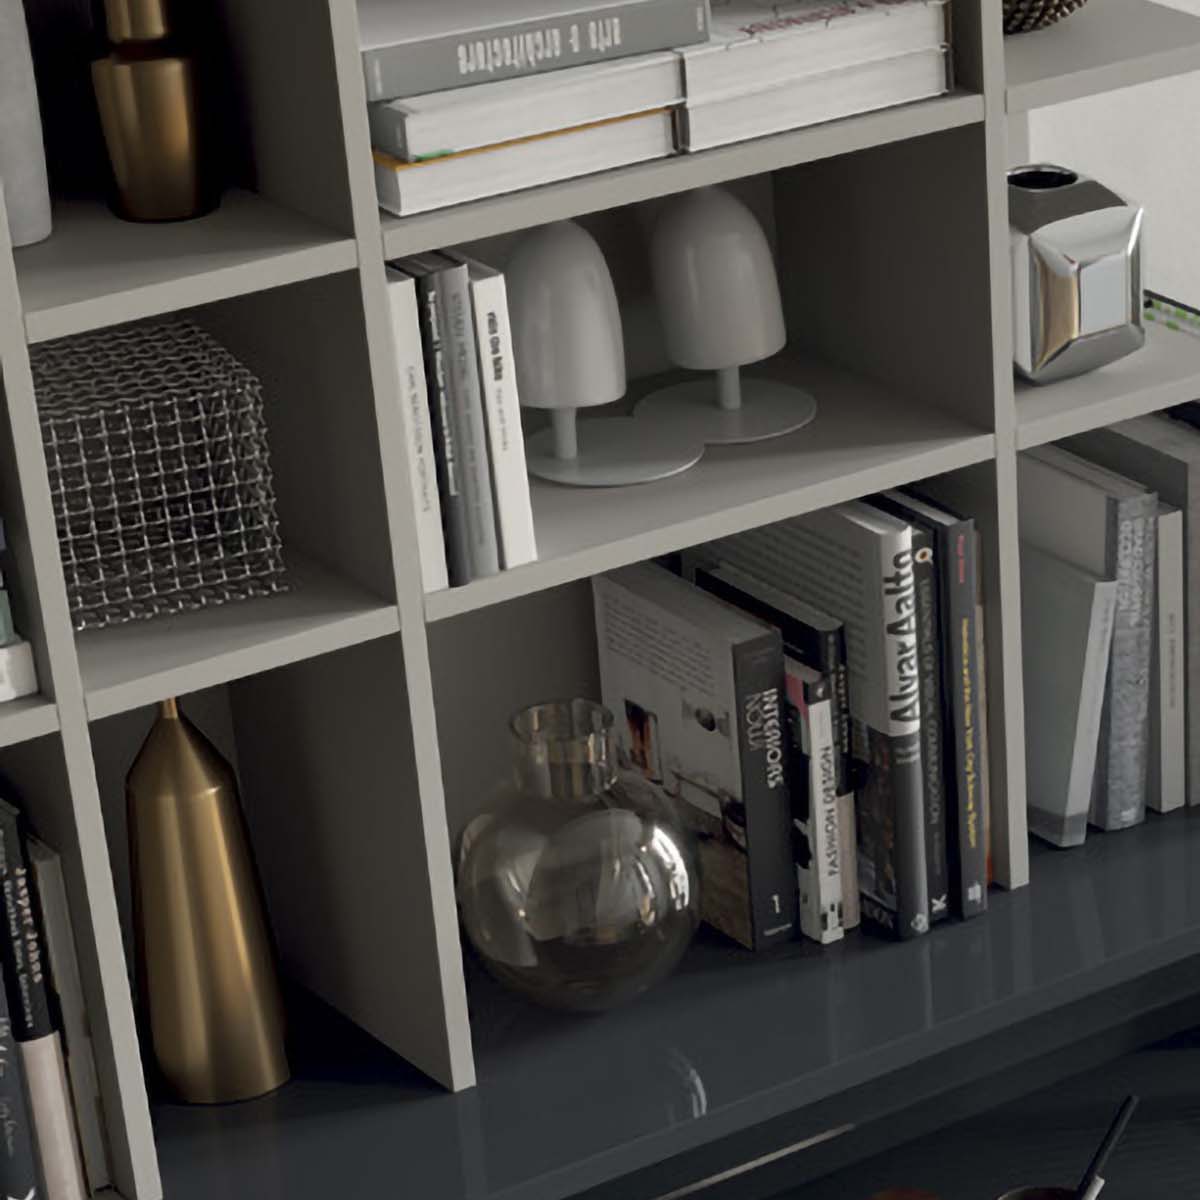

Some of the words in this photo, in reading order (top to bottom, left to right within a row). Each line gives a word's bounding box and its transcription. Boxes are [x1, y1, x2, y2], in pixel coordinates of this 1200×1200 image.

[457, 28, 561, 74] architecture
[588, 17, 621, 52] arts
[883, 549, 916, 636] Aalto
[889, 641, 920, 722] Alvar
[763, 688, 784, 788] INTERIORS
[823, 808, 840, 877] FASHION
